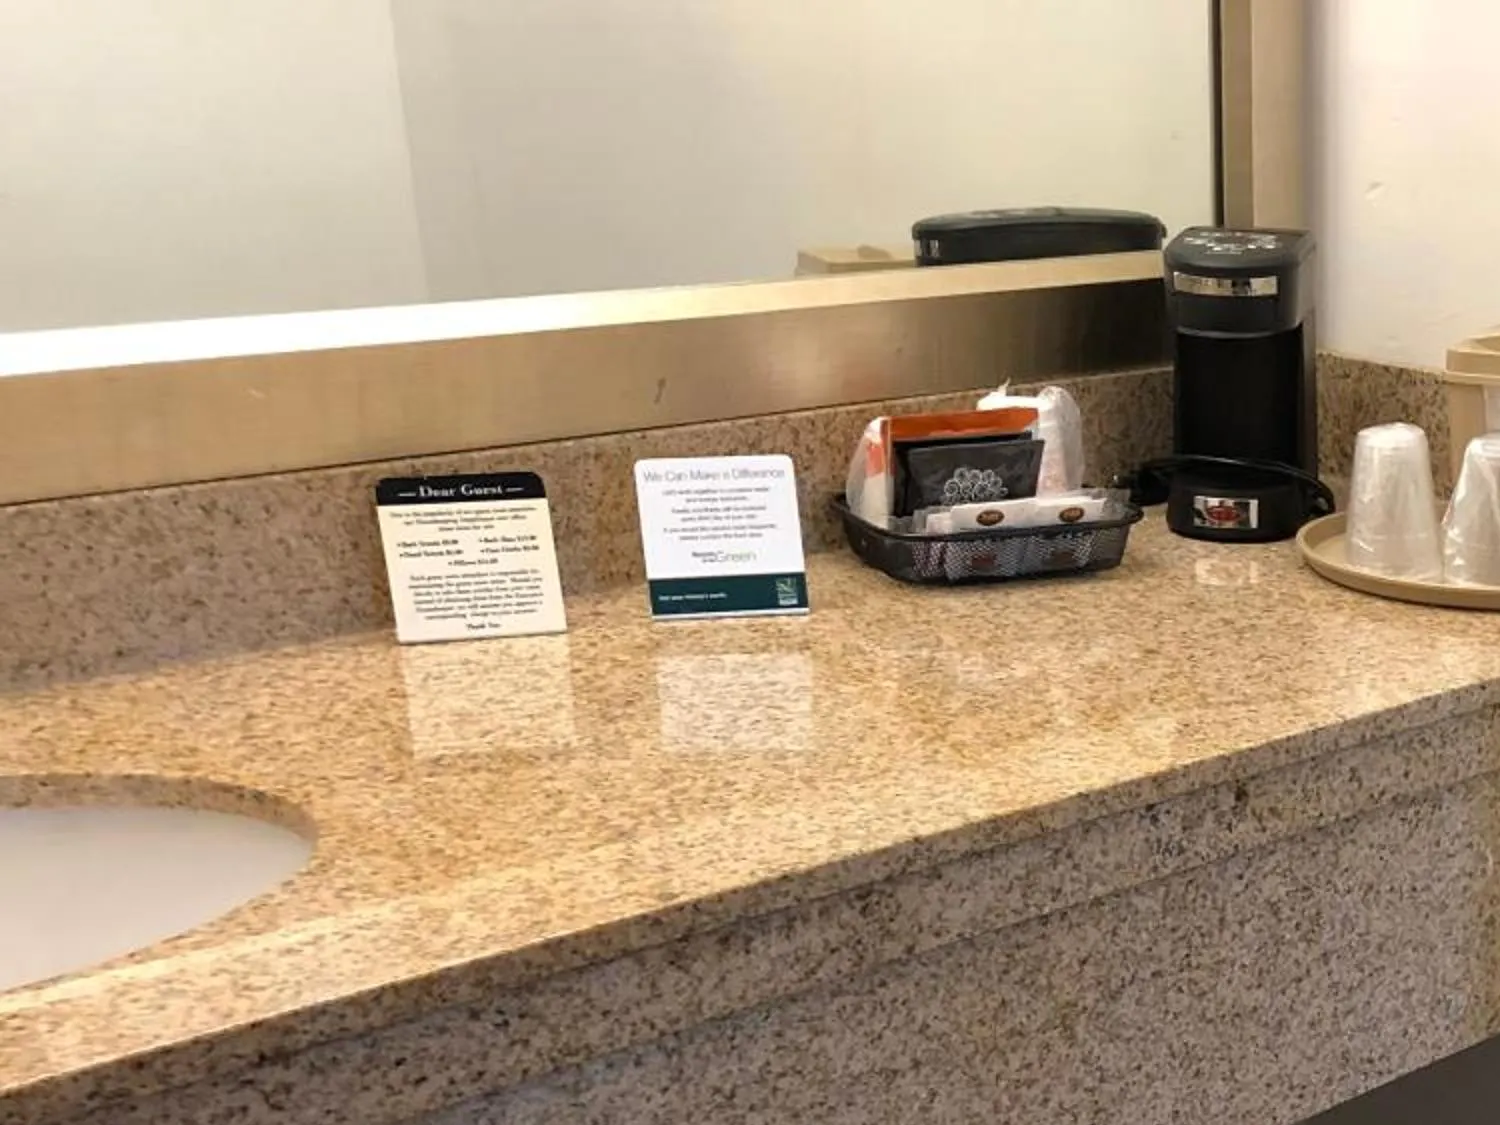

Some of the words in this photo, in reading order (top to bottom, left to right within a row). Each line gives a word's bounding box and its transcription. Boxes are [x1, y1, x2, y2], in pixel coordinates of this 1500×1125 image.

[643, 471, 663, 482] We
[665, 470, 689, 481] Can
[690, 468, 720, 481] Make
[731, 467, 785, 480] Difference
[419, 484, 457, 498] Dear
[460, 482, 503, 497] Guest
